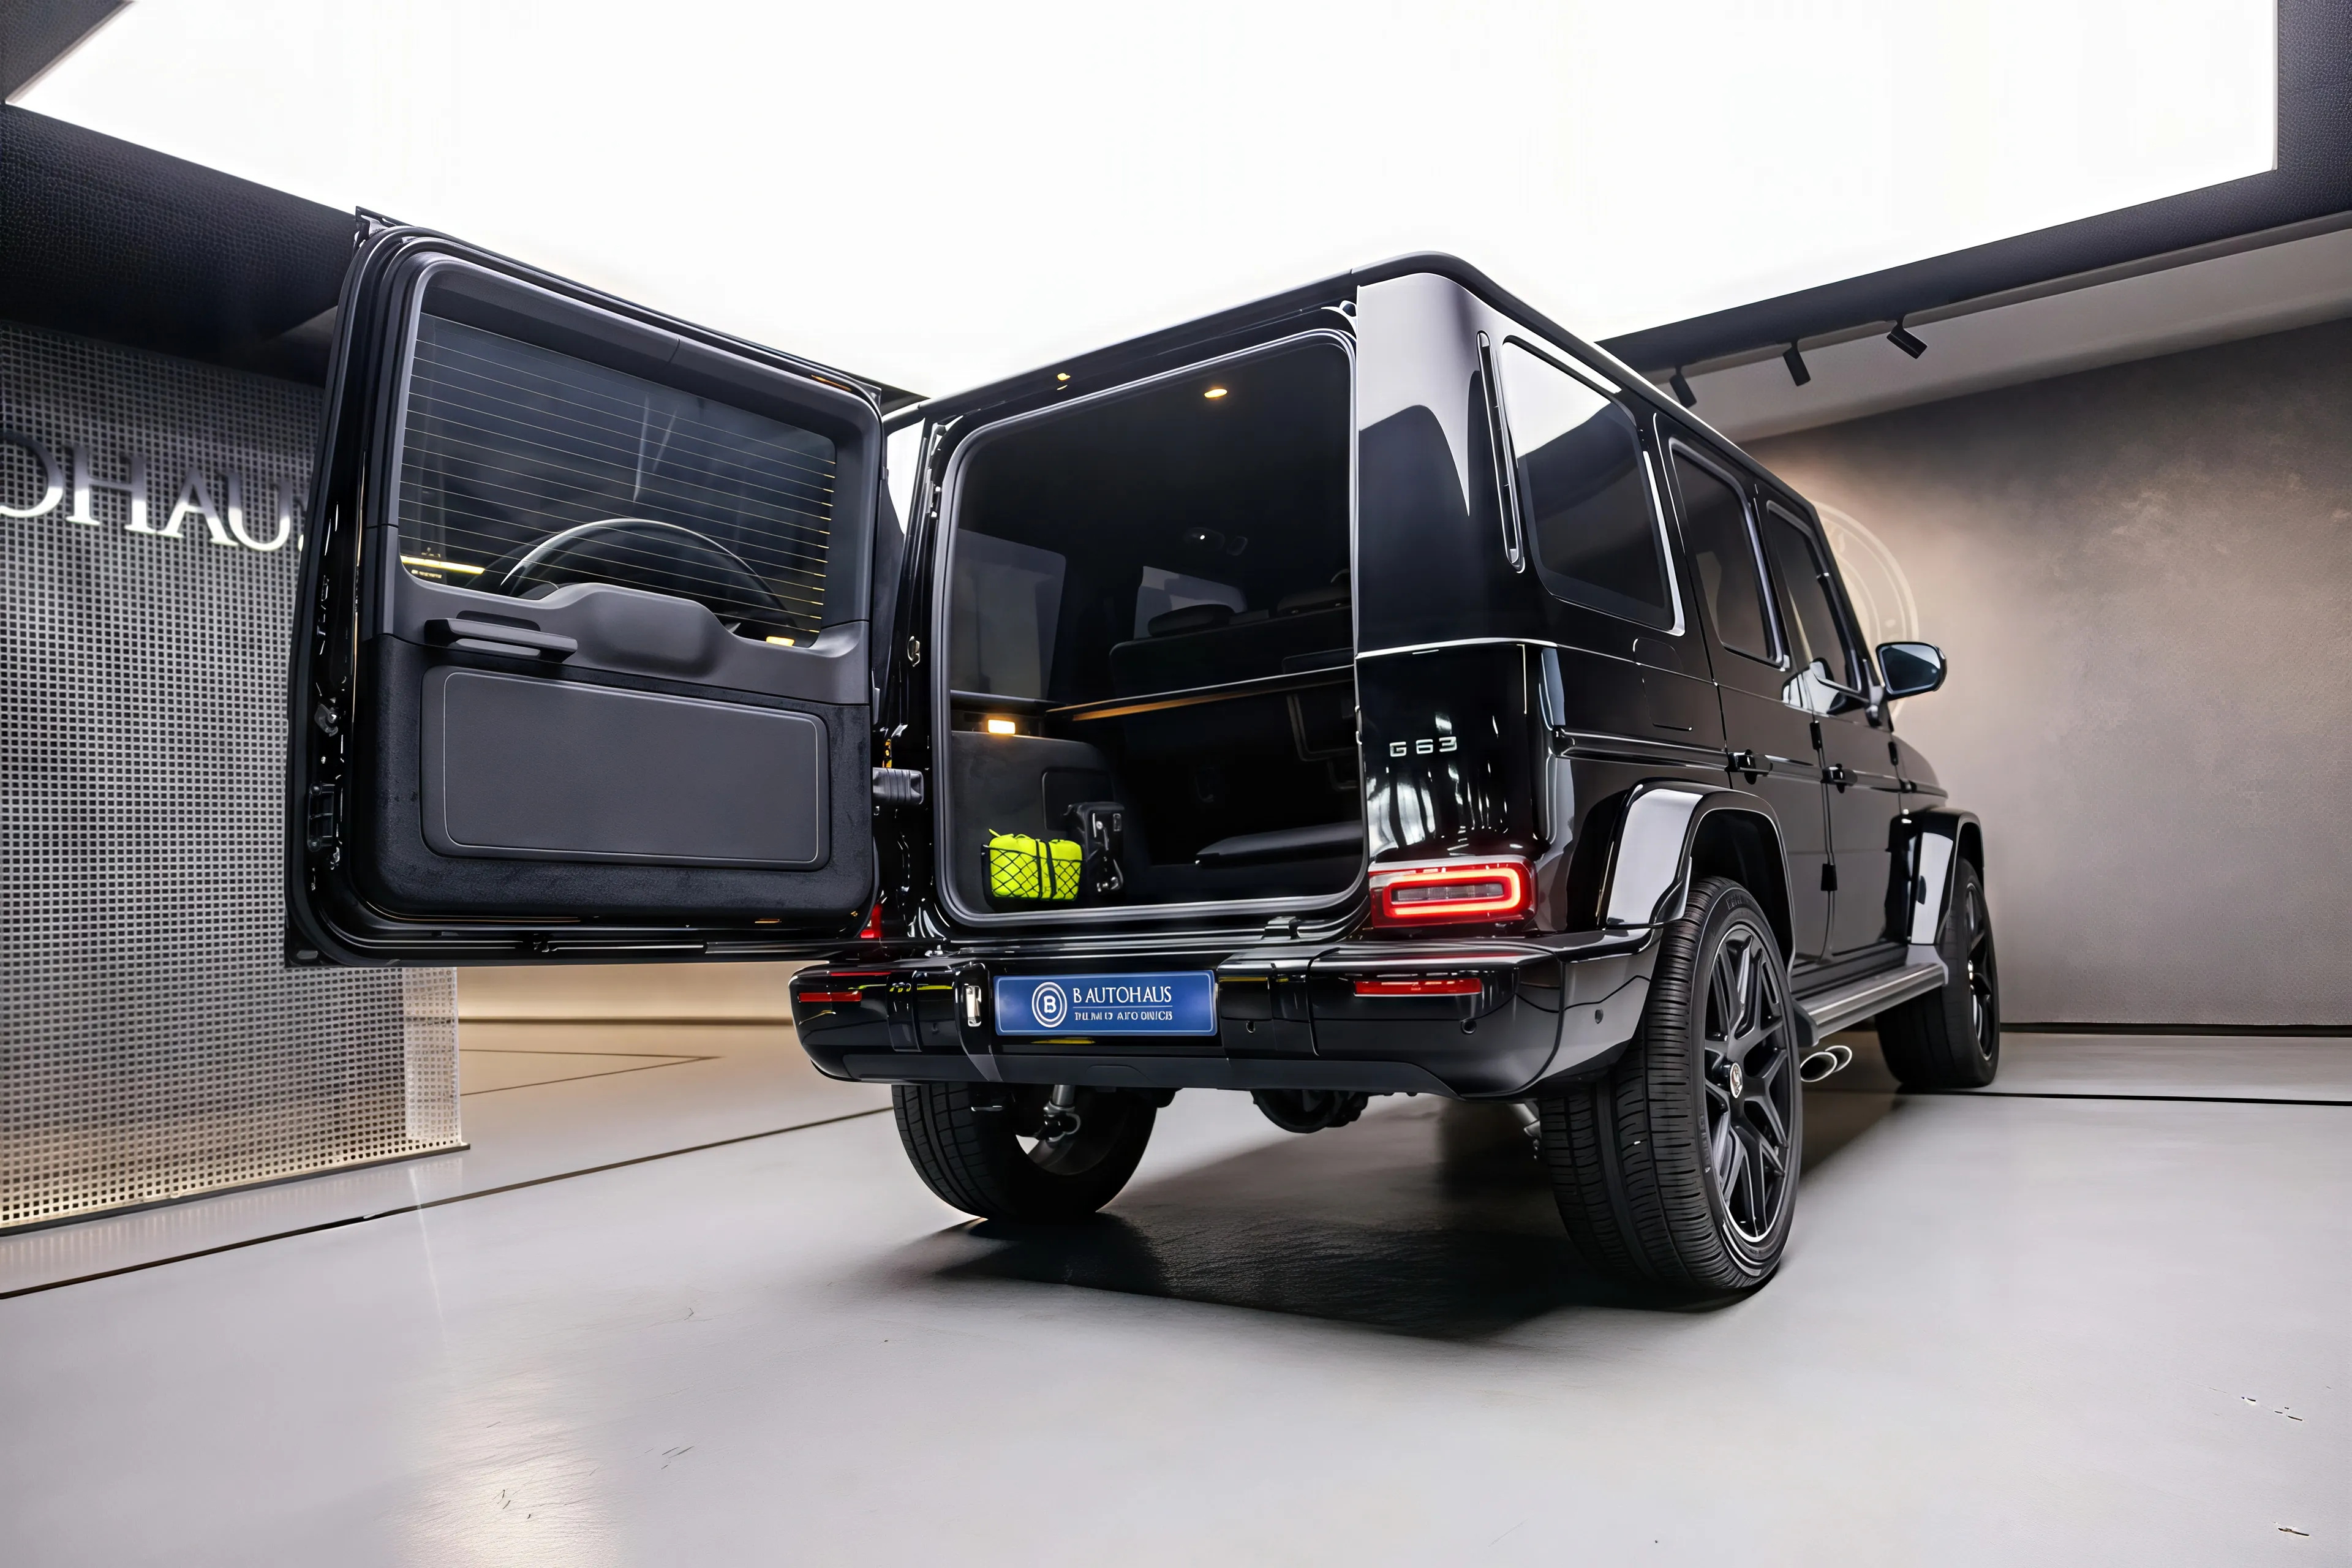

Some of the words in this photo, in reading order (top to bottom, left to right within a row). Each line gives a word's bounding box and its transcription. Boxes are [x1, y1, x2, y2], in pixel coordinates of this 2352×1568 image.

[0, 430, 304, 551] OHAU
[1389, 741, 1407, 757] G
[1415, 736, 1457, 755] 63
[1044, 995, 1057, 1013] B
[1073, 987, 1082, 1003] B
[1085, 986, 1172, 1003] AUTOHAUS
